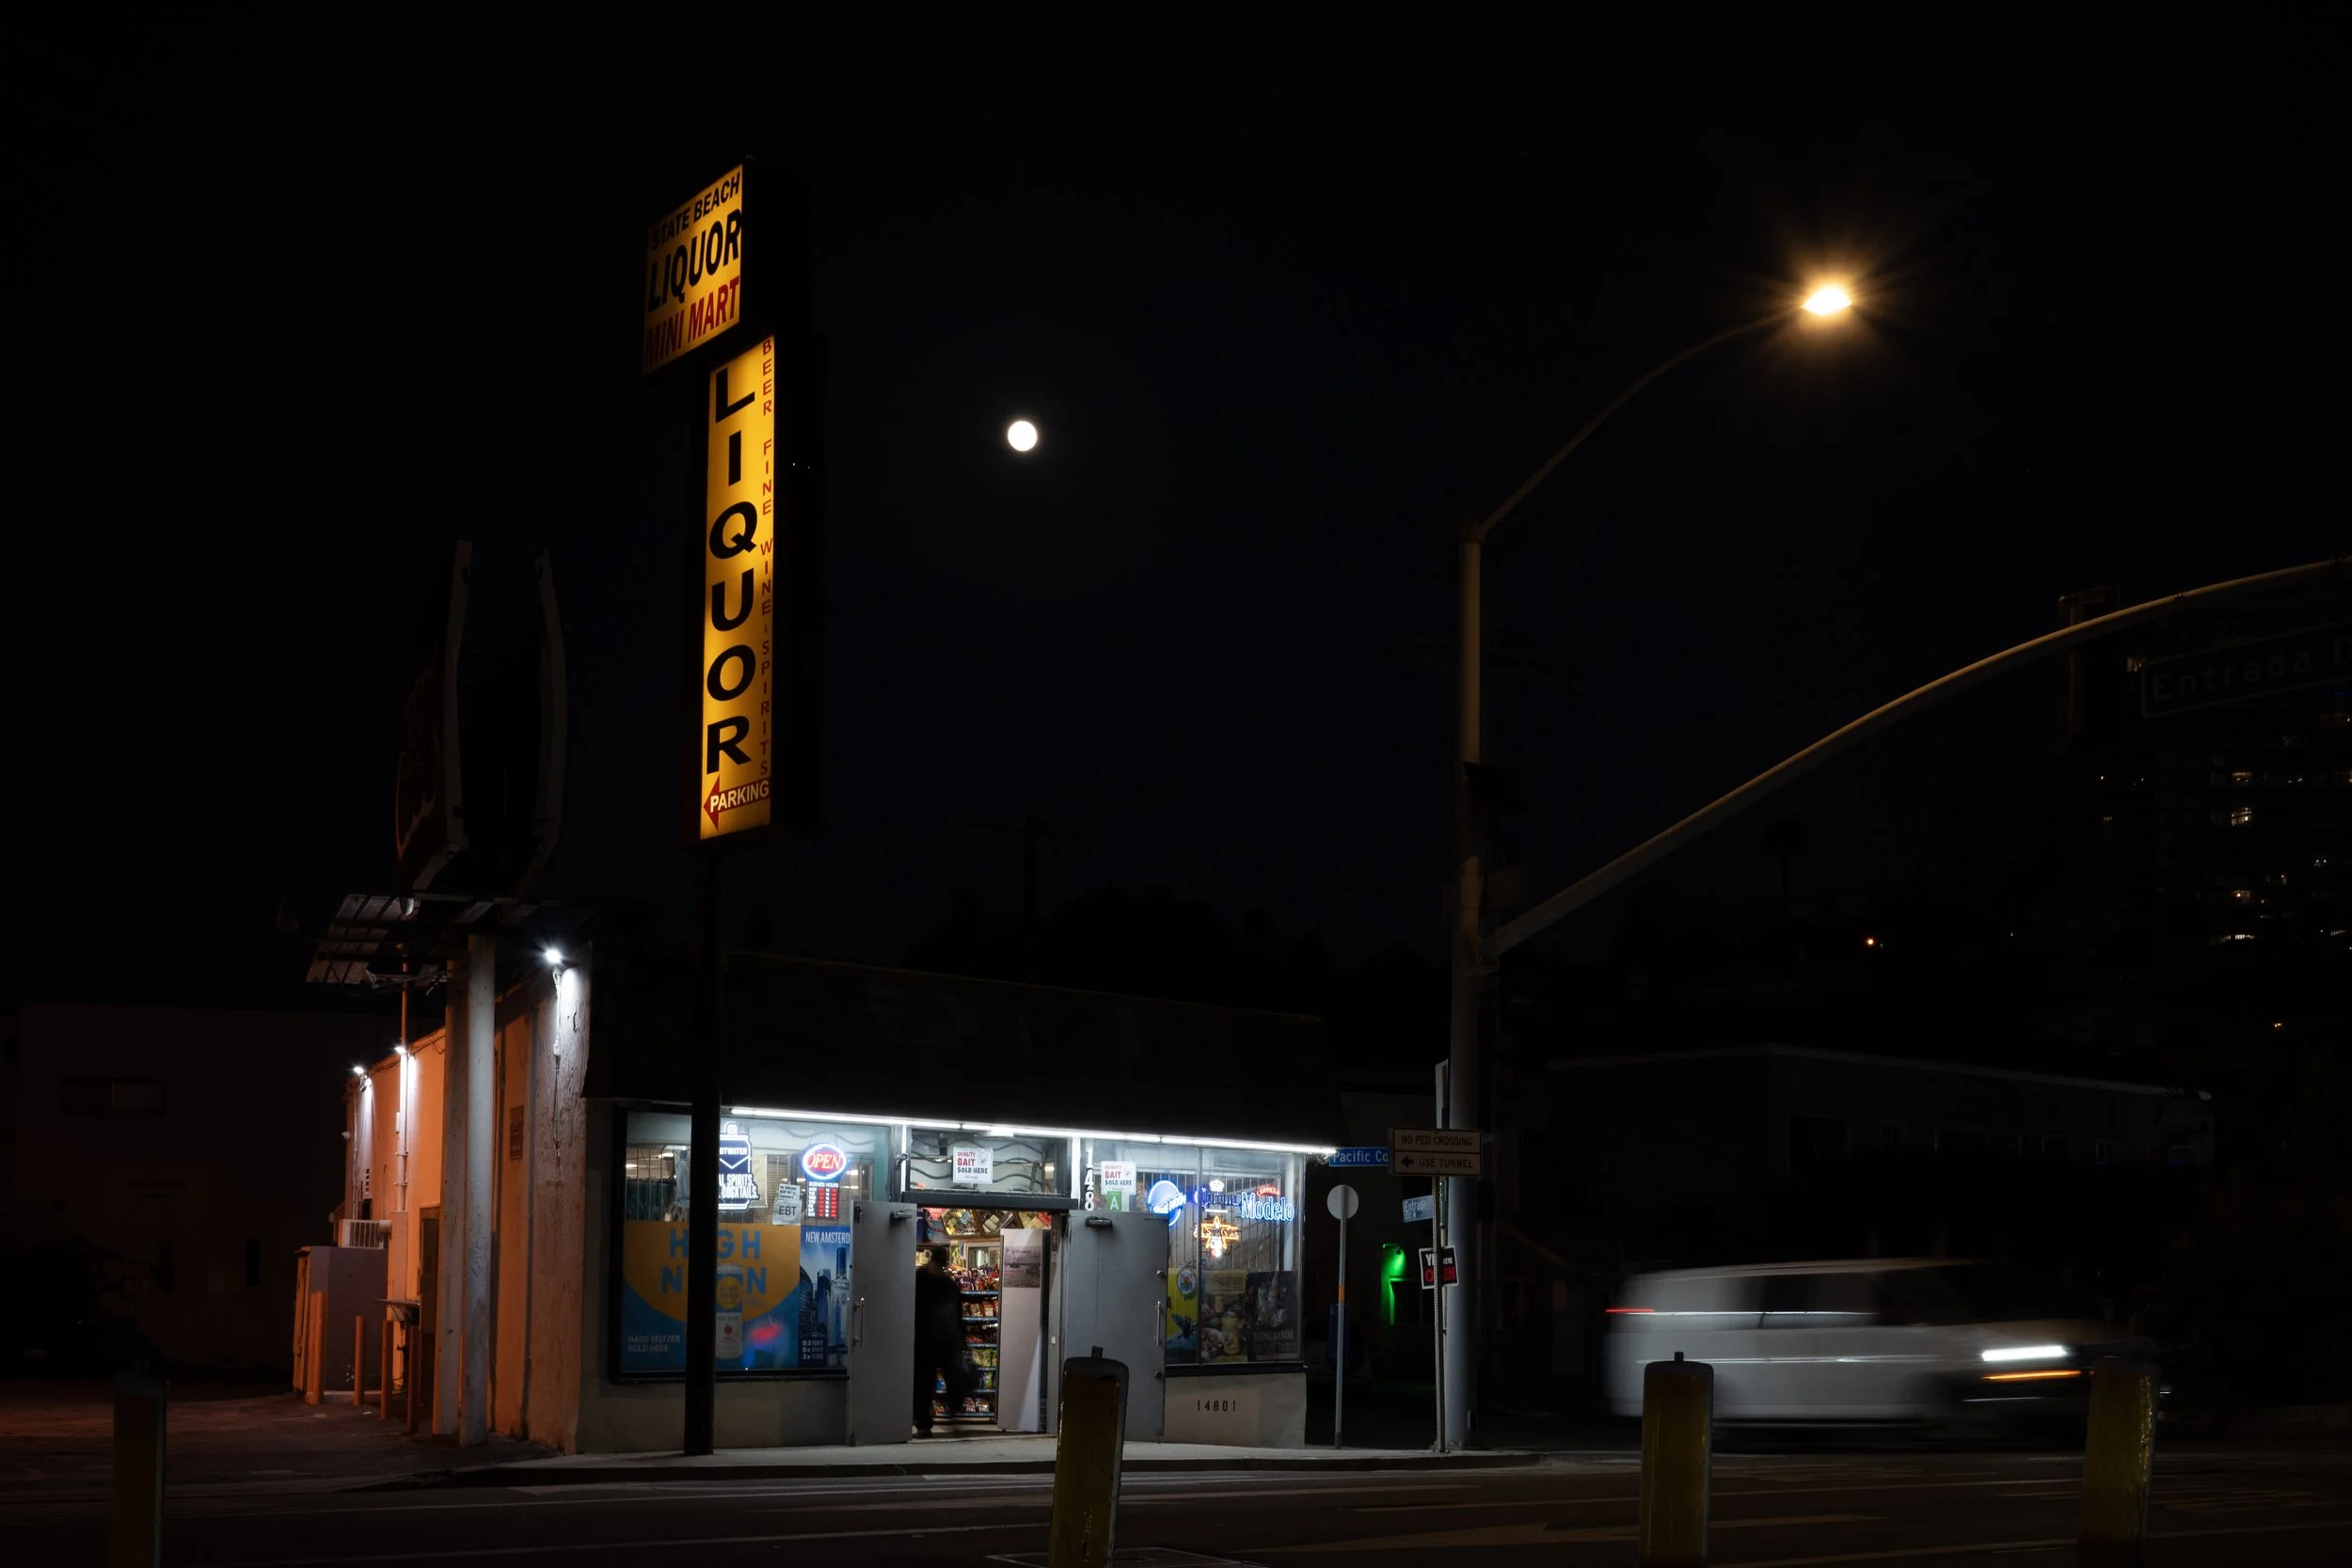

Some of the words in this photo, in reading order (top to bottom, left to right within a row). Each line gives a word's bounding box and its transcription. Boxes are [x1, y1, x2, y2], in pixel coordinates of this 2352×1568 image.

[651, 208, 691, 250] STATE
[693, 172, 740, 224] BEACH
[647, 208, 742, 314] LIQUOR
[644, 309, 685, 368] MINI
[687, 276, 739, 344] MART
[762, 339, 772, 416] BEER
[762, 438, 772, 516] FINE
[707, 367, 758, 775] LIQUOR
[759, 537, 773, 616] WINE
[2152, 648, 2312, 702] Entrada
[759, 640, 771, 776] SPIRITS
[709, 779, 770, 814] PARKING
[1401, 1134, 1412, 1145] NO
[1415, 1135, 1432, 1146] PED
[1434, 1135, 1473, 1147] CROSSING
[807, 1152, 841, 1169] OPEN
[957, 1158, 976, 1166] BAIT
[1333, 1149, 1371, 1163] Pacific
[1419, 1158, 1437, 1167] USE
[1439, 1159, 1474, 1169] TUNNEL
[1104, 1170, 1121, 1179] BAIT
[778, 1205, 798, 1217] EBT
[1109, 1195, 1120, 1211] A
[1240, 1192, 1295, 1222] Modelo
[670, 1227, 761, 1259] HGH
[805, 1231, 819, 1243] NEW
[661, 1266, 767, 1295] NN
[1423, 1265, 1455, 1284] OEN
[1197, 1399, 1236, 1412] 14801
